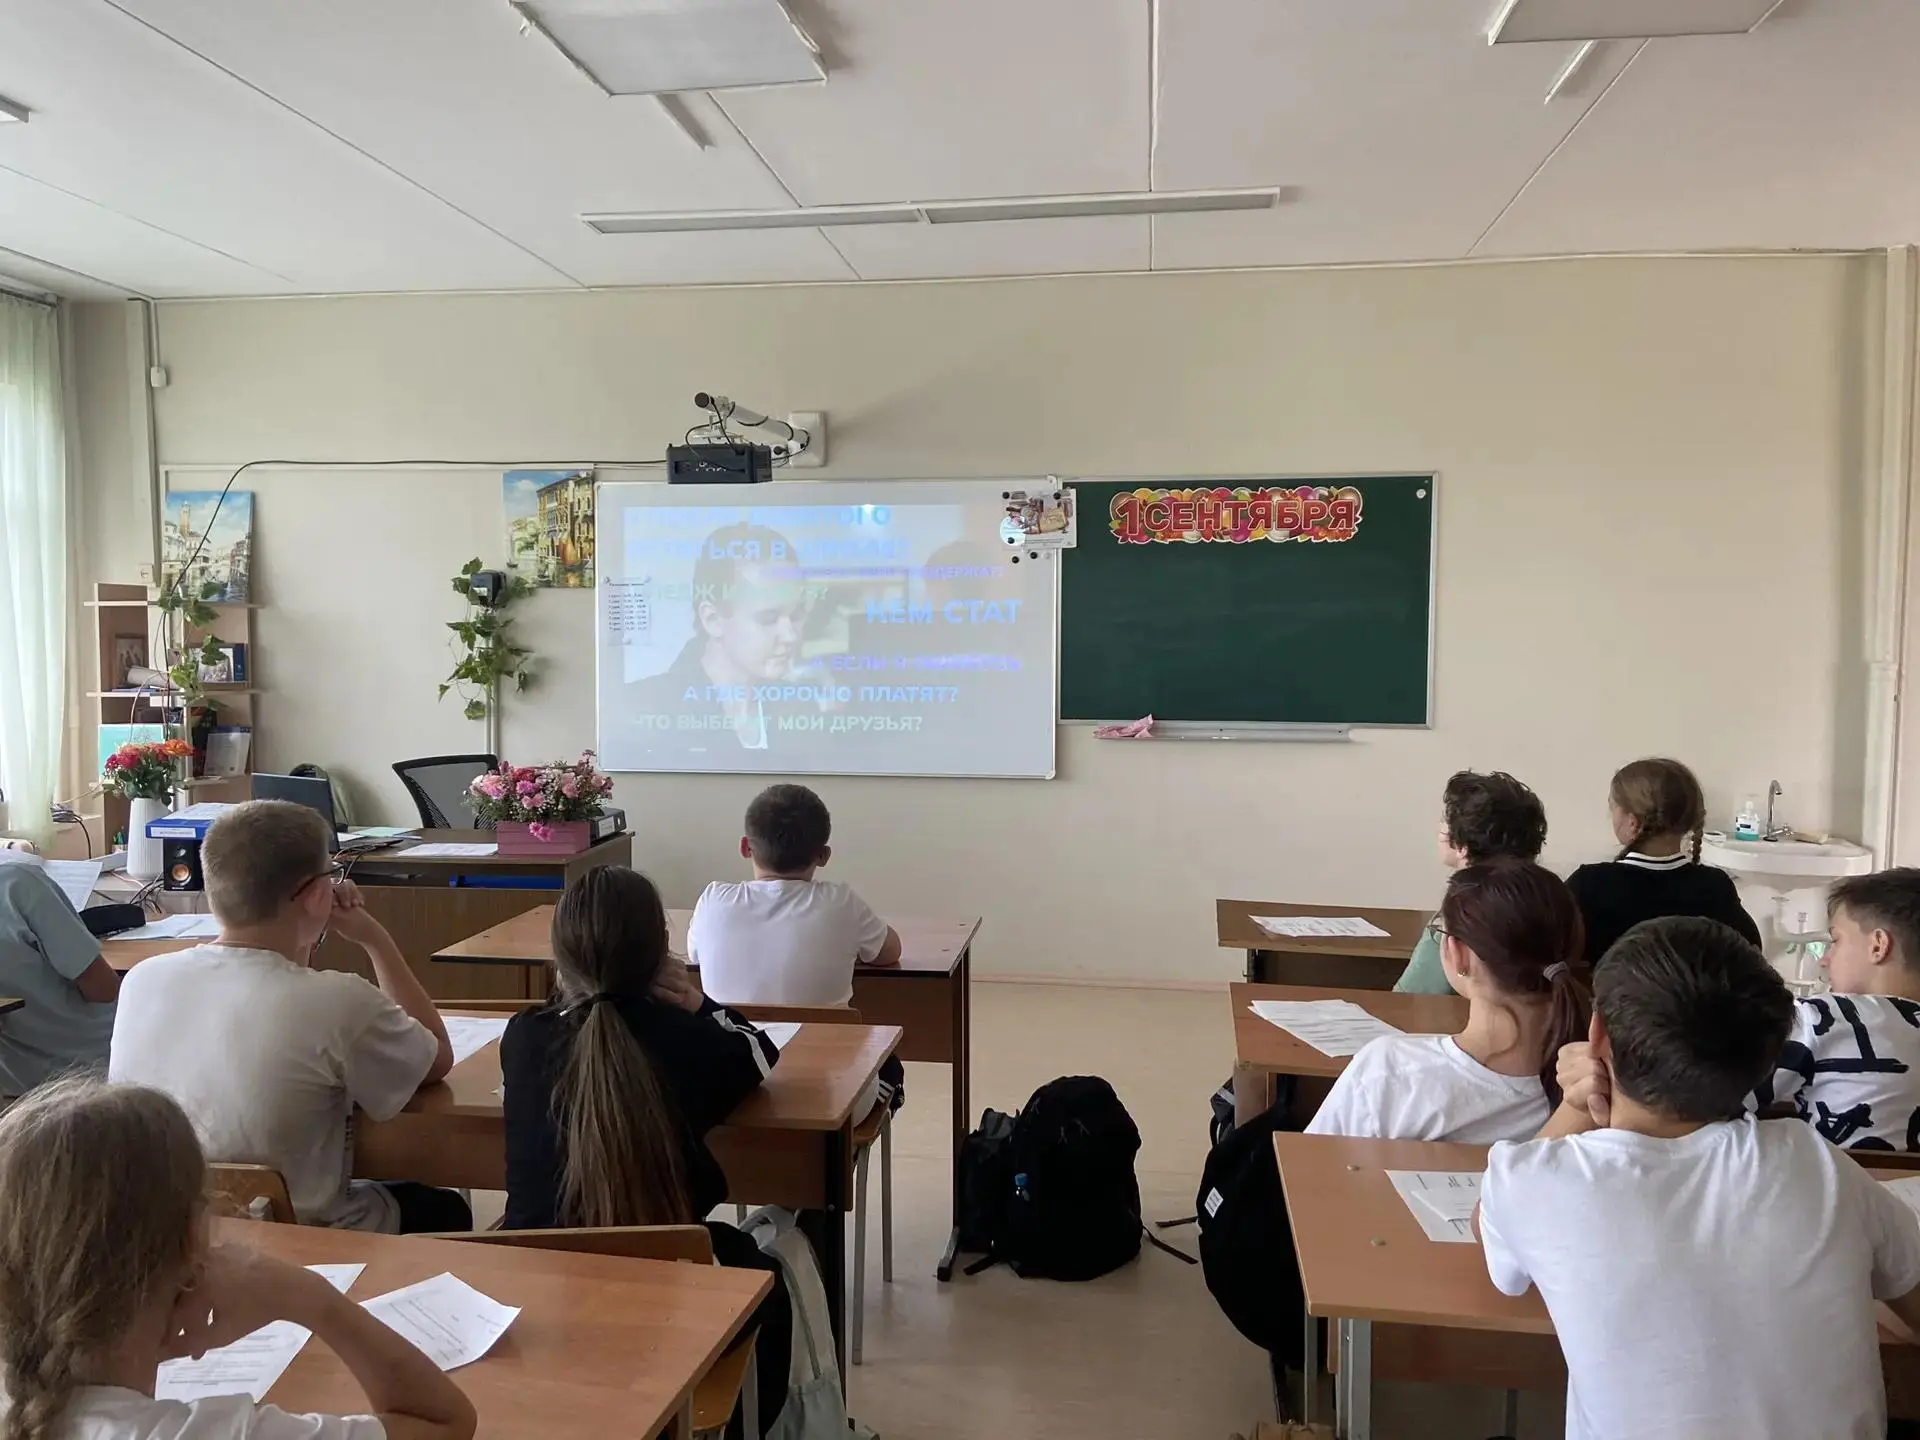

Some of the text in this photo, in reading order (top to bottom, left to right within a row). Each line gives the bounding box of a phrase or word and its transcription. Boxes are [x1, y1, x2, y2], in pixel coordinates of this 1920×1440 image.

[1115, 499, 1358, 537] 1 СЕНТЯБРЯ
[864, 598, 934, 625] КЕМ
[682, 685, 960, 704] А ГДЕ ХОРОШО ПЛАТЯТ?
[776, 713, 825, 732] МОИ
[829, 713, 924, 734] ДРУЗЬЯ?
